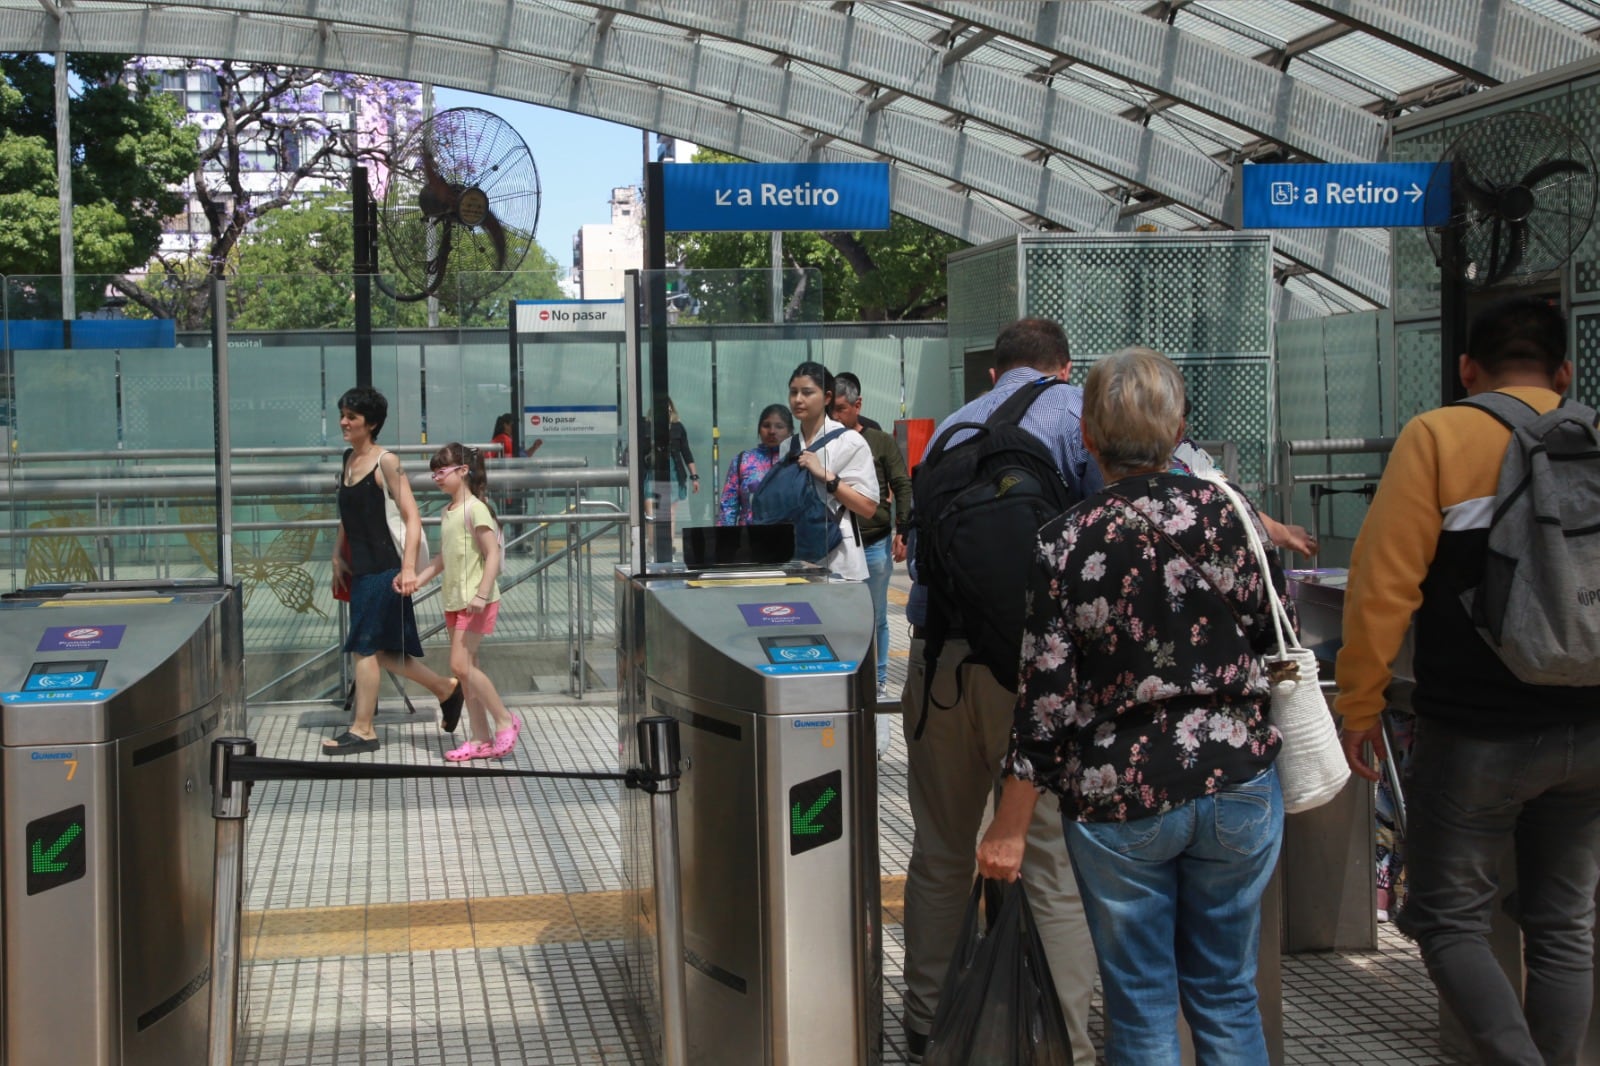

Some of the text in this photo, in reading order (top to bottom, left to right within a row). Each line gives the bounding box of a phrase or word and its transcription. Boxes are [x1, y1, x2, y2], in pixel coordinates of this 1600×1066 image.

[738, 183, 840, 206] a Retiro
[1303, 181, 1400, 205] a Retiro
[552, 310, 607, 323] No pasar
[542, 416, 576, 425] No pasar
[794, 719, 832, 728] GUNNEBO
[822, 728, 835, 748] 8
[64, 760, 79, 781] 7
